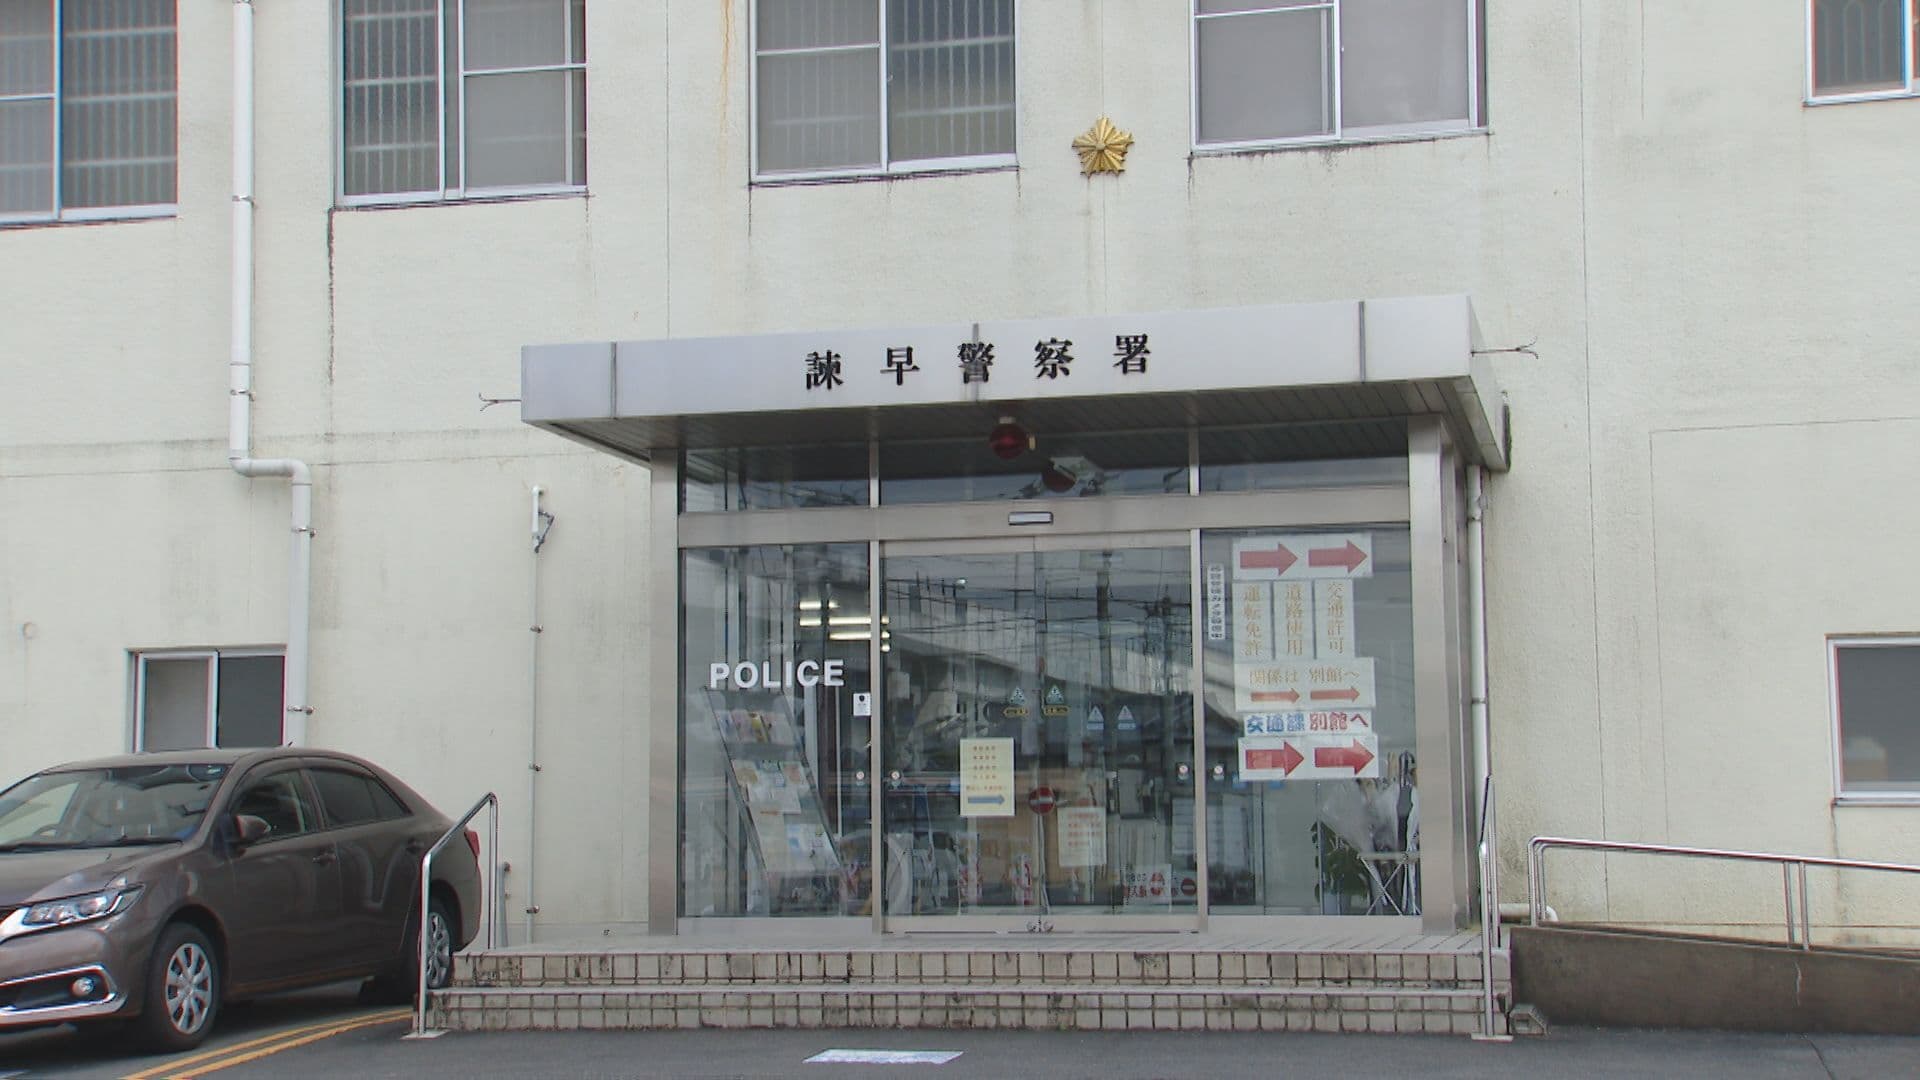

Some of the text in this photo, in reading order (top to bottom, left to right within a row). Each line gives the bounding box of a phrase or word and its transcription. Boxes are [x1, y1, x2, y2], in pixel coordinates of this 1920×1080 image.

[1243, 585, 1261, 656] 運転免許
[1286, 584, 1303, 655] 道路使用
[1327, 583, 1344, 654] 交通許可
[710, 660, 844, 689] POLICE
